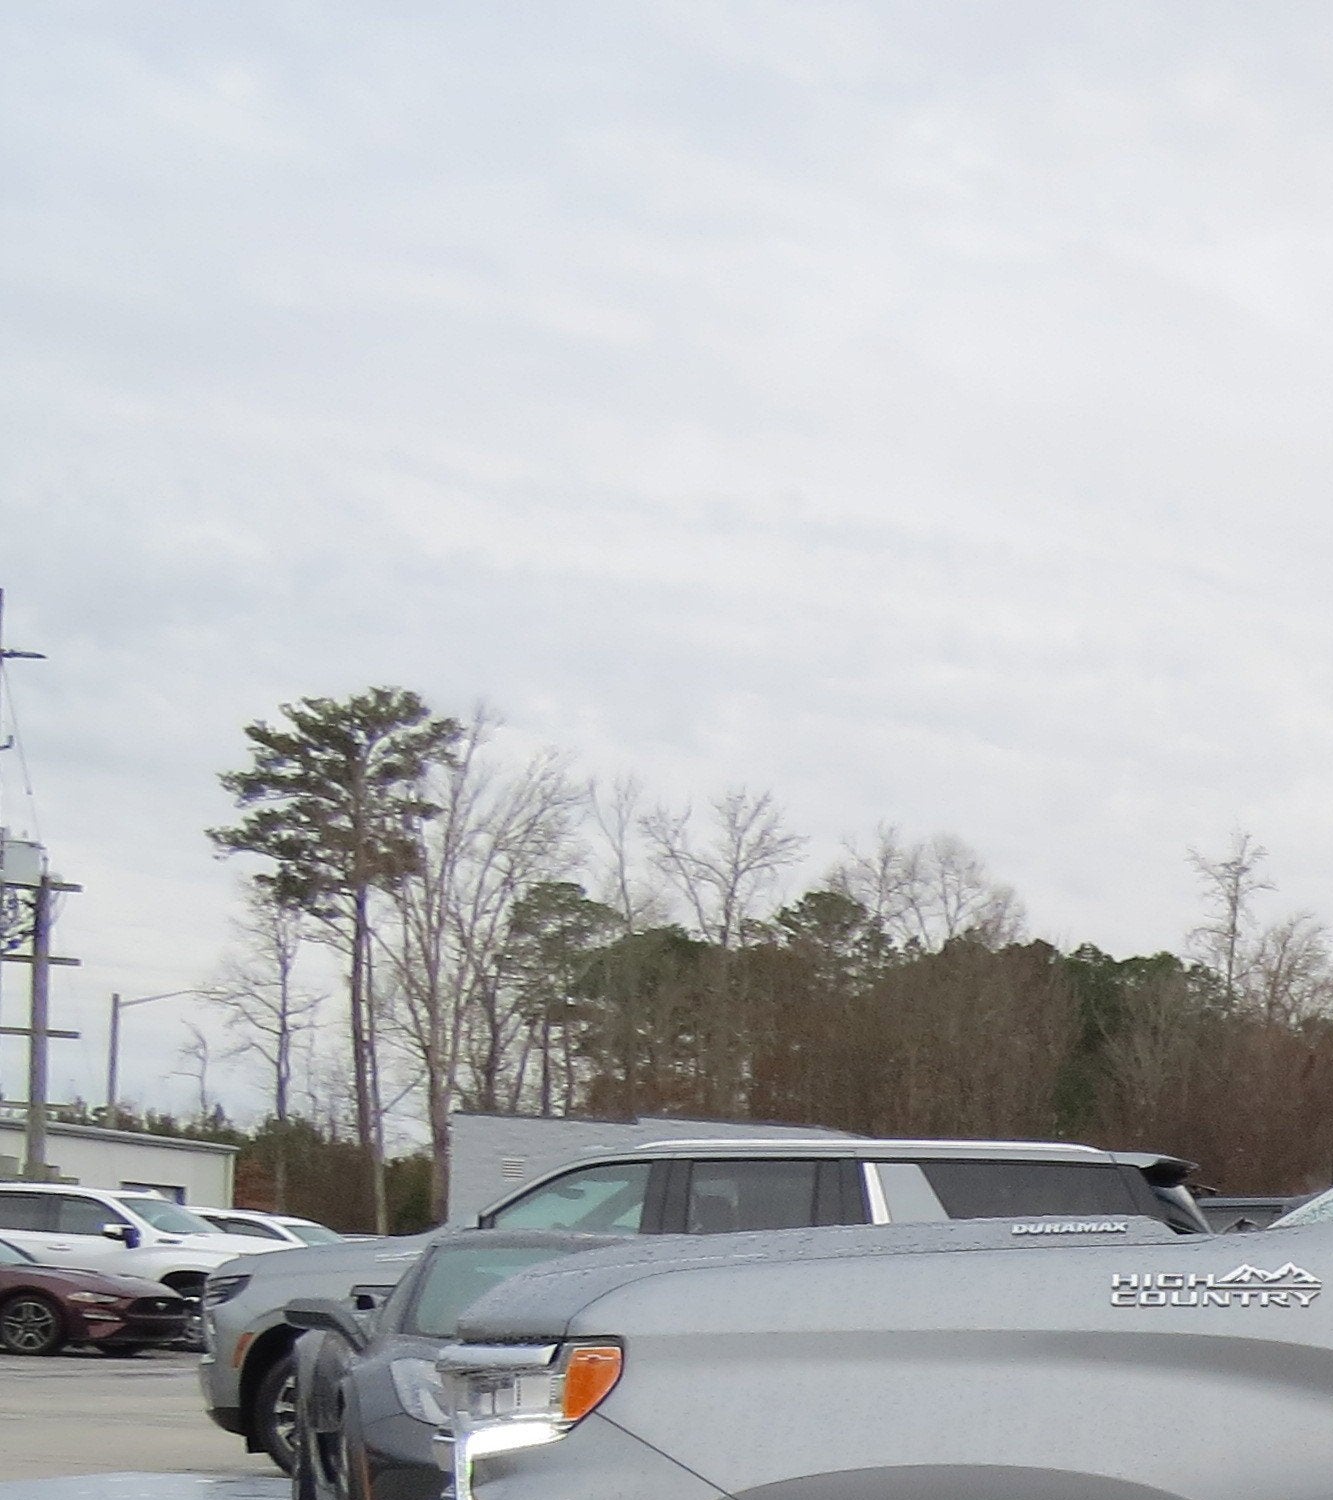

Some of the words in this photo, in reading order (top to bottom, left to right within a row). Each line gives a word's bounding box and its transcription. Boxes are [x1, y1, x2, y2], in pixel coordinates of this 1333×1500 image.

[1011, 1221, 1129, 1236] DURAMAX
[1111, 1273, 1215, 1290] HIGH
[1111, 1290, 1321, 1307] COUNTRY
